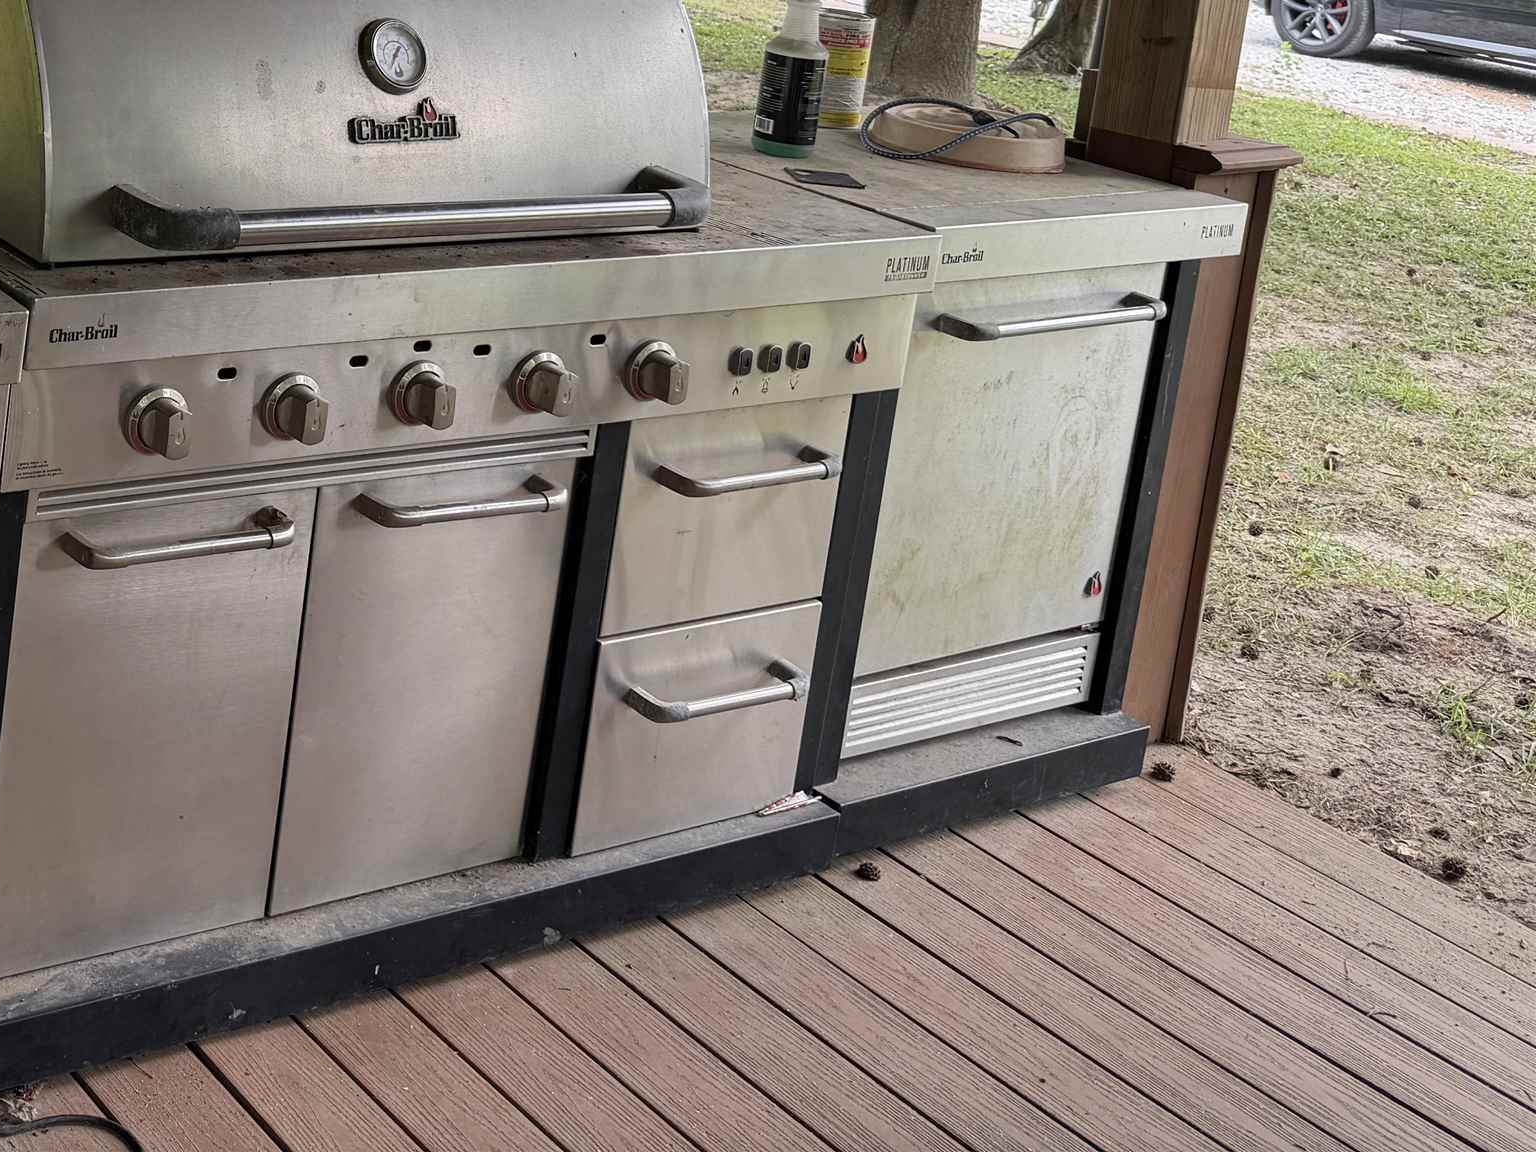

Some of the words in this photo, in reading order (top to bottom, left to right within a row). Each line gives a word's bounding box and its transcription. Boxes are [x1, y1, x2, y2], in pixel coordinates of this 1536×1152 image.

[349, 114, 459, 143] Char-Broil
[885, 256, 930, 273] PLATINUM
[941, 250, 984, 265] Char-Broil
[48, 324, 119, 344] Char-Broil
